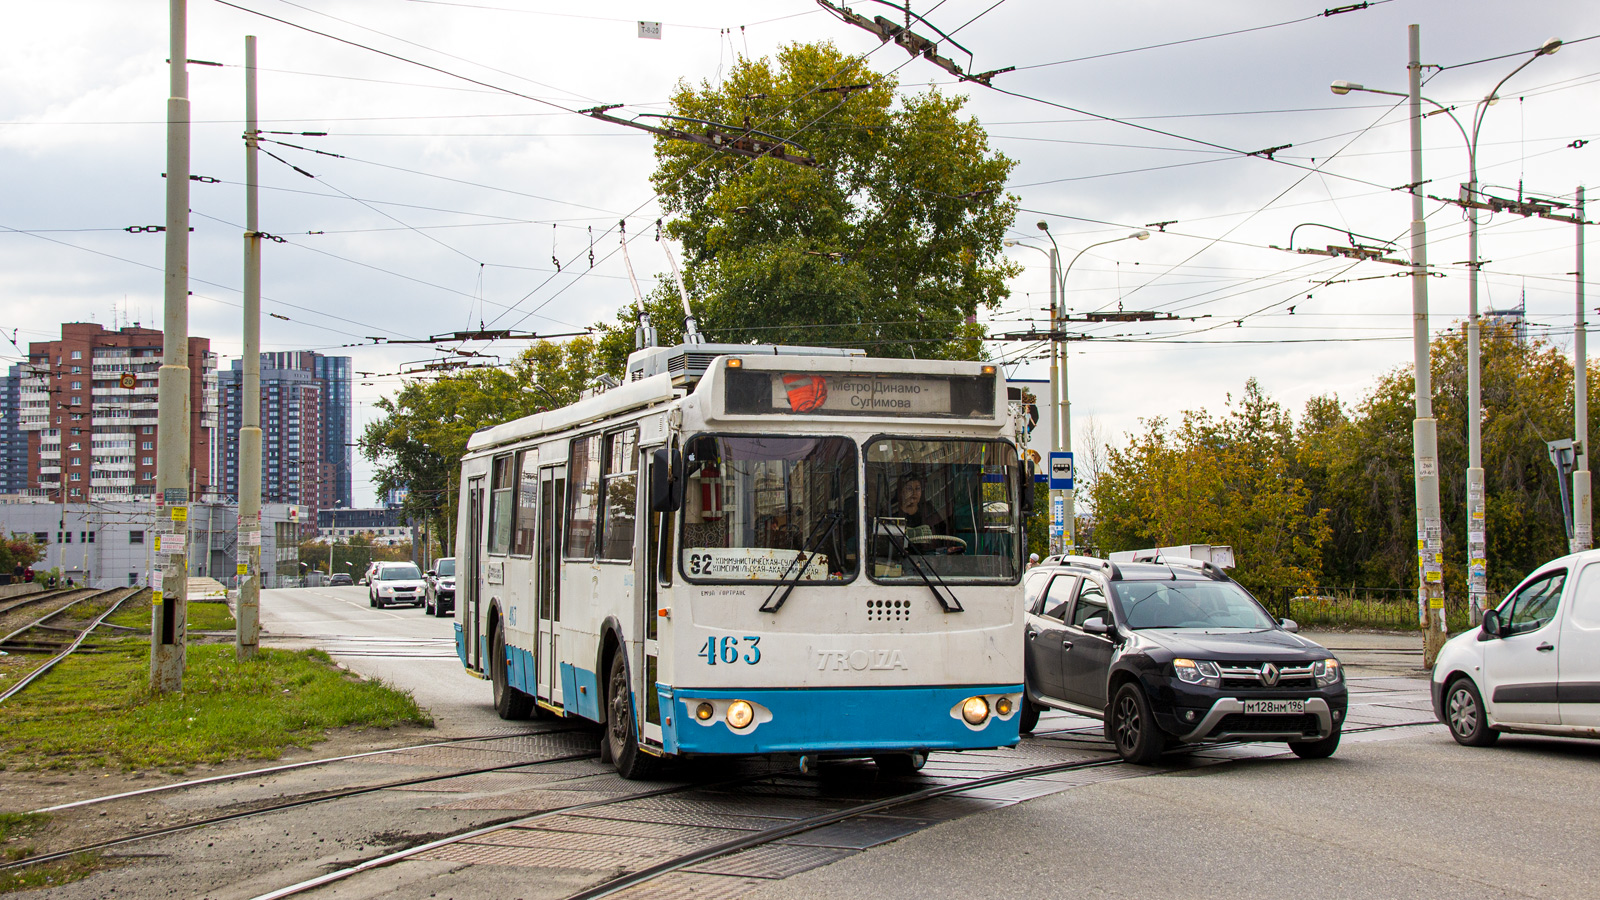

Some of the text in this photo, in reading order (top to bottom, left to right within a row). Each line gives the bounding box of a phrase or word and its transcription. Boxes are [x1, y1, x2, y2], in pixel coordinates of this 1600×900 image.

[832, 381, 871, 394] Метро
[873, 382, 921, 394] Динамо
[850, 395, 911, 409] Сулимова
[690, 553, 713, 575] 32
[697, 635, 762, 665] 463
[816, 649, 908, 671] TROLZA
[1288, 701, 1303, 709] 196
